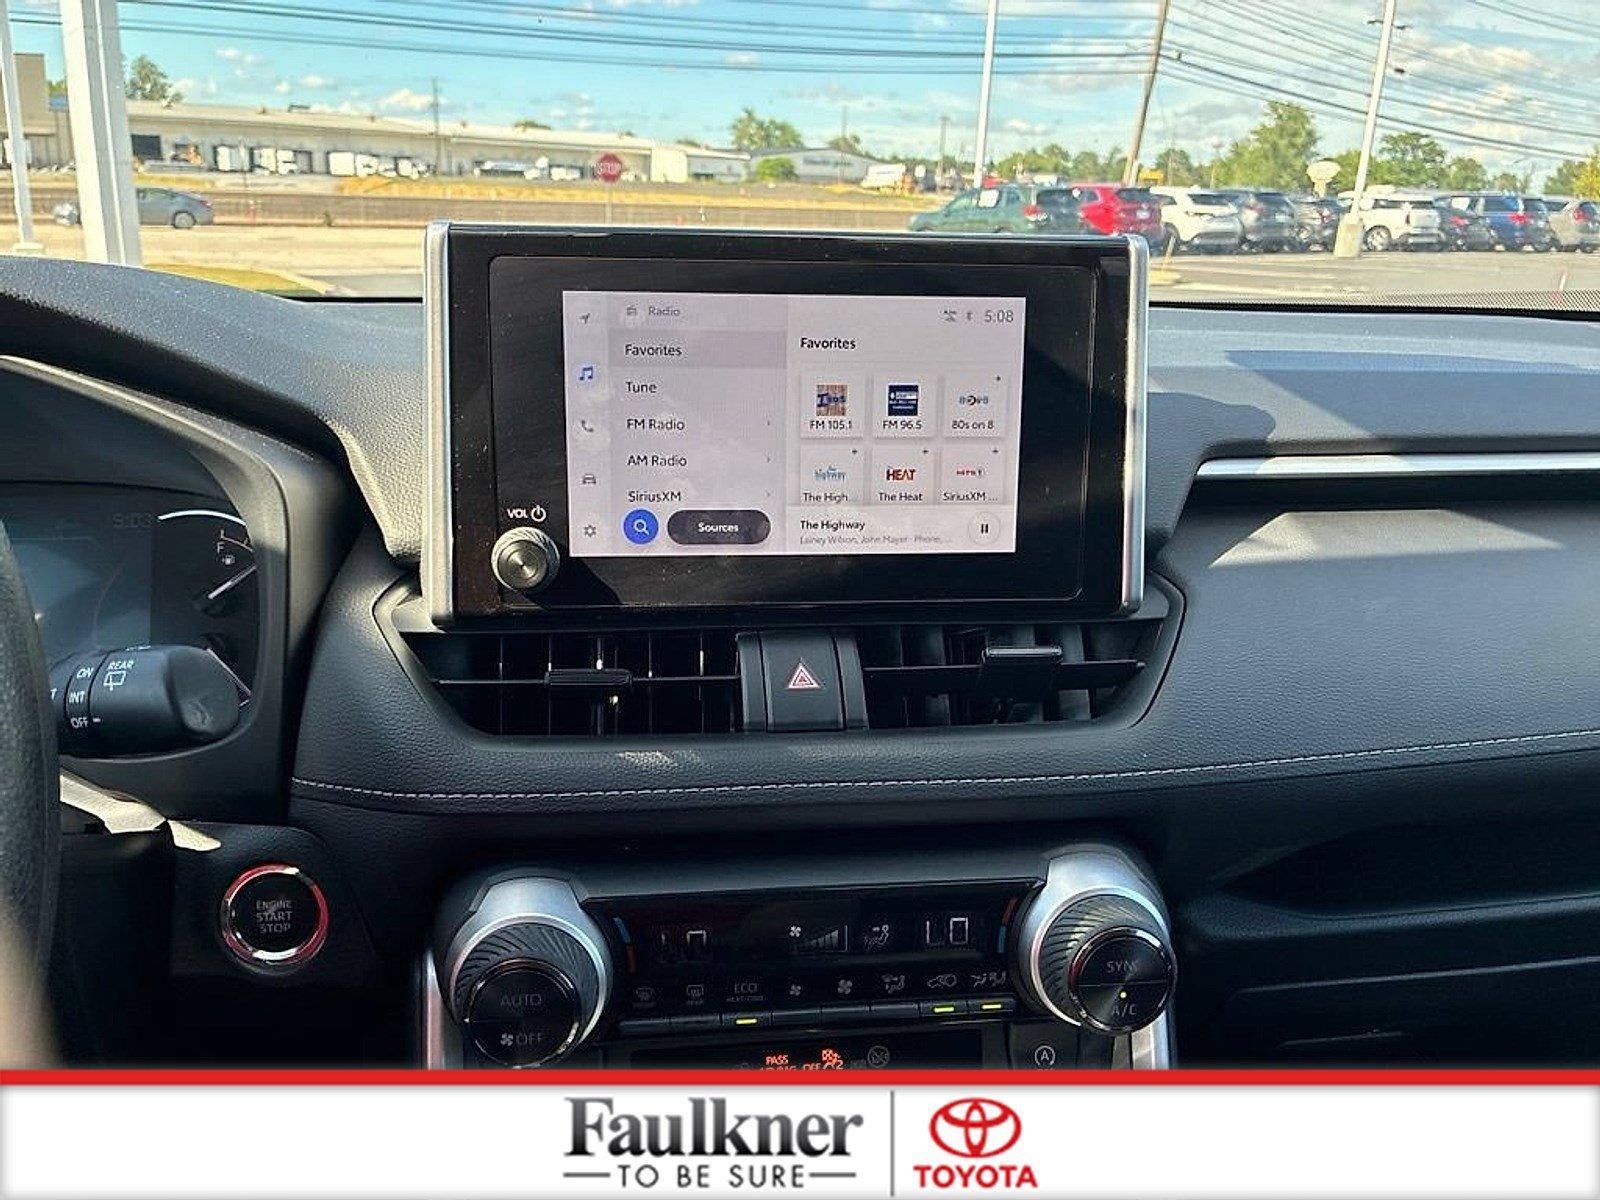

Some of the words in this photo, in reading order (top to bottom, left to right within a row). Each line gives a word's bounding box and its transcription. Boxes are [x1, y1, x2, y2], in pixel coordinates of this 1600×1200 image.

[648, 306, 681, 317] Radio
[984, 310, 1014, 323] 5:08
[800, 337, 856, 350] Favorites
[625, 344, 683, 357] Favorites
[625, 382, 658, 394] Tune
[627, 419, 646, 430] FM
[649, 419, 685, 431] Radio
[809, 420, 825, 430] FM
[828, 420, 853, 430] 105.1
[882, 420, 898, 430] FM
[900, 420, 923, 430] 96.5
[952, 420, 970, 430] 80s
[971, 421, 986, 430] on
[987, 420, 994, 430] 8
[627, 455, 648, 466] AM
[651, 455, 688, 467] Radio
[885, 468, 916, 481] HEAT
[628, 490, 682, 503] SiriusXM
[803, 492, 822, 501] The
[878, 492, 897, 502] The
[899, 492, 923, 502] Heat
[943, 492, 986, 502] SiriusXM
[507, 508, 529, 519] VOL
[698, 521, 739, 533] Sources
[800, 520, 819, 530] The
[820, 519, 866, 533] Highway
[217, 541, 225, 554] F
[107, 660, 134, 670] REAR
[76, 667, 94, 679] ON
[69, 690, 85, 703] INT
[70, 717, 88, 729] OFF
[256, 900, 293, 910] ENGINE
[256, 911, 293, 922] START
[259, 922, 291, 934] STOP
[734, 982, 758, 994] ECO
[501, 993, 542, 1007] AUTO
[1112, 1003, 1138, 1017] A/C
[515, 1032, 542, 1046] OFF
[765, 1054, 789, 1065] PASS
